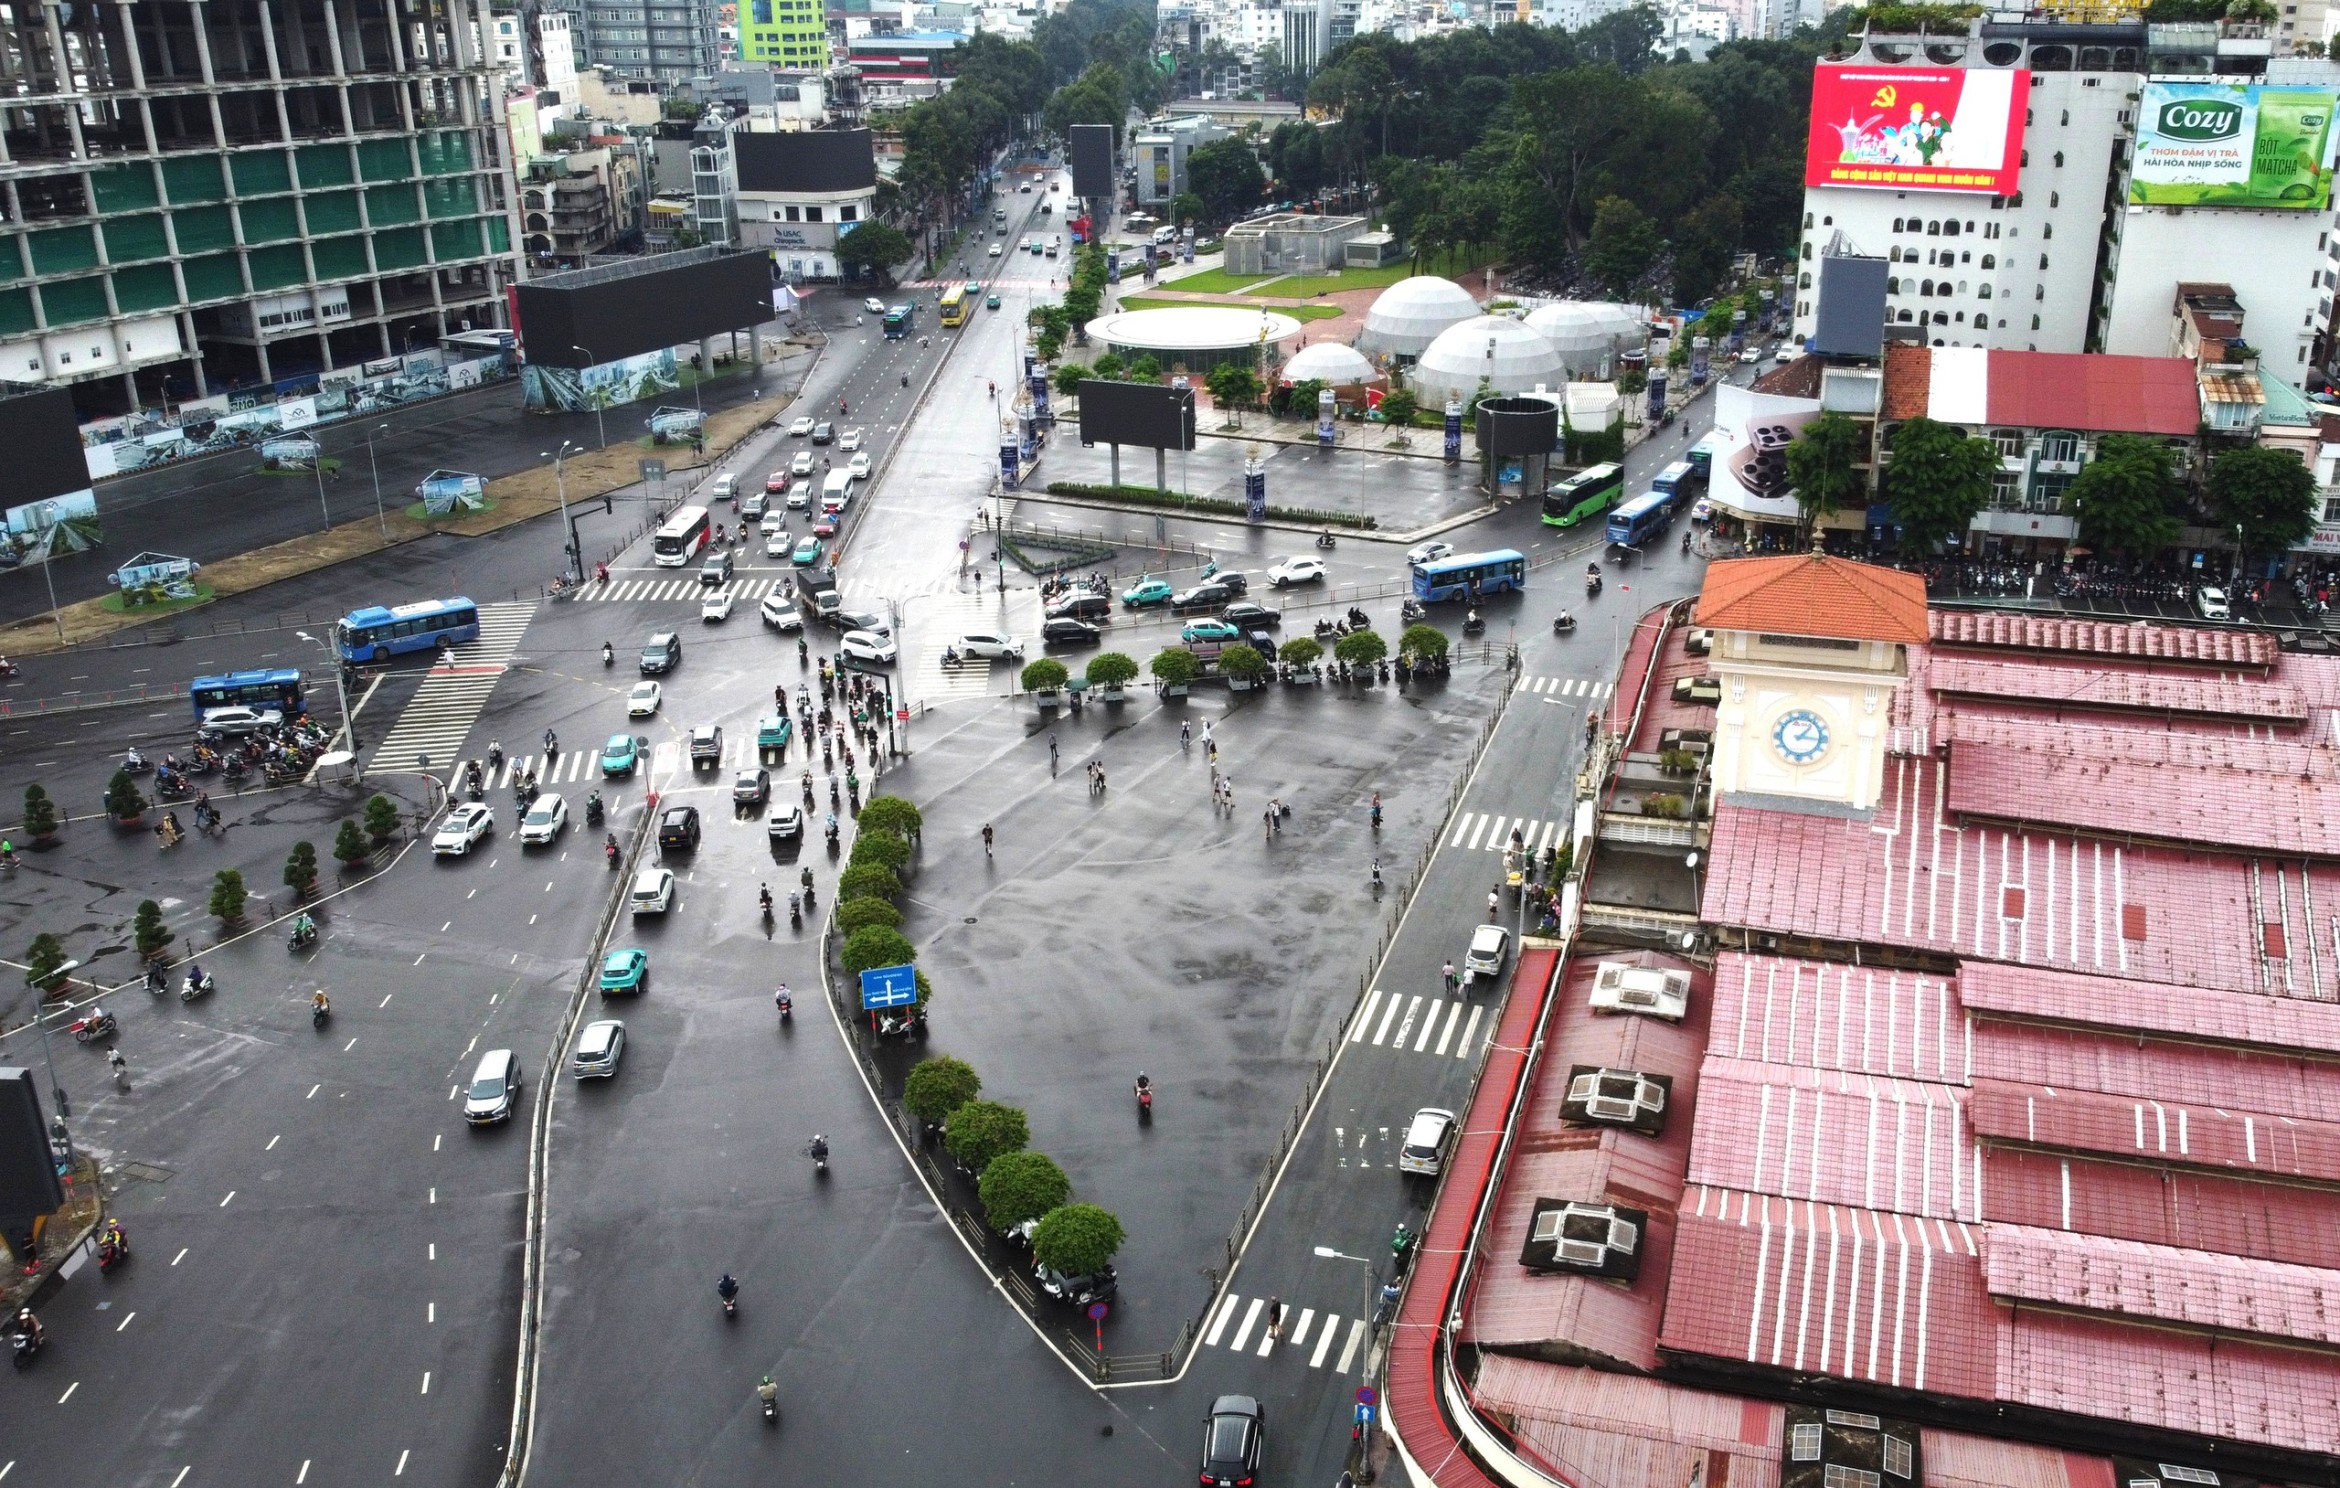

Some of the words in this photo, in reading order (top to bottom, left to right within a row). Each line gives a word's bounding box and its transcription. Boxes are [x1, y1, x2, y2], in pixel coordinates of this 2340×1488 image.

[2166, 106, 2233, 134] Cozy
[2302, 116, 2322, 125] Cozy
[2150, 147, 2179, 157] THƠM
[2181, 147, 2204, 159] ĐẬM
[2206, 147, 2218, 160] VỊ
[2219, 147, 2239, 158] TRÀ
[2258, 137, 2279, 156] BỘT
[2143, 156, 2162, 167] HÀI
[2163, 156, 2185, 168] HÒA
[2187, 159, 2212, 171] NHỊP
[2214, 158, 2243, 170] SỐNG
[2255, 157, 2298, 177] MATCHA
[783, 230, 801, 238] USAC
[2314, 533, 2333, 542] MAI
